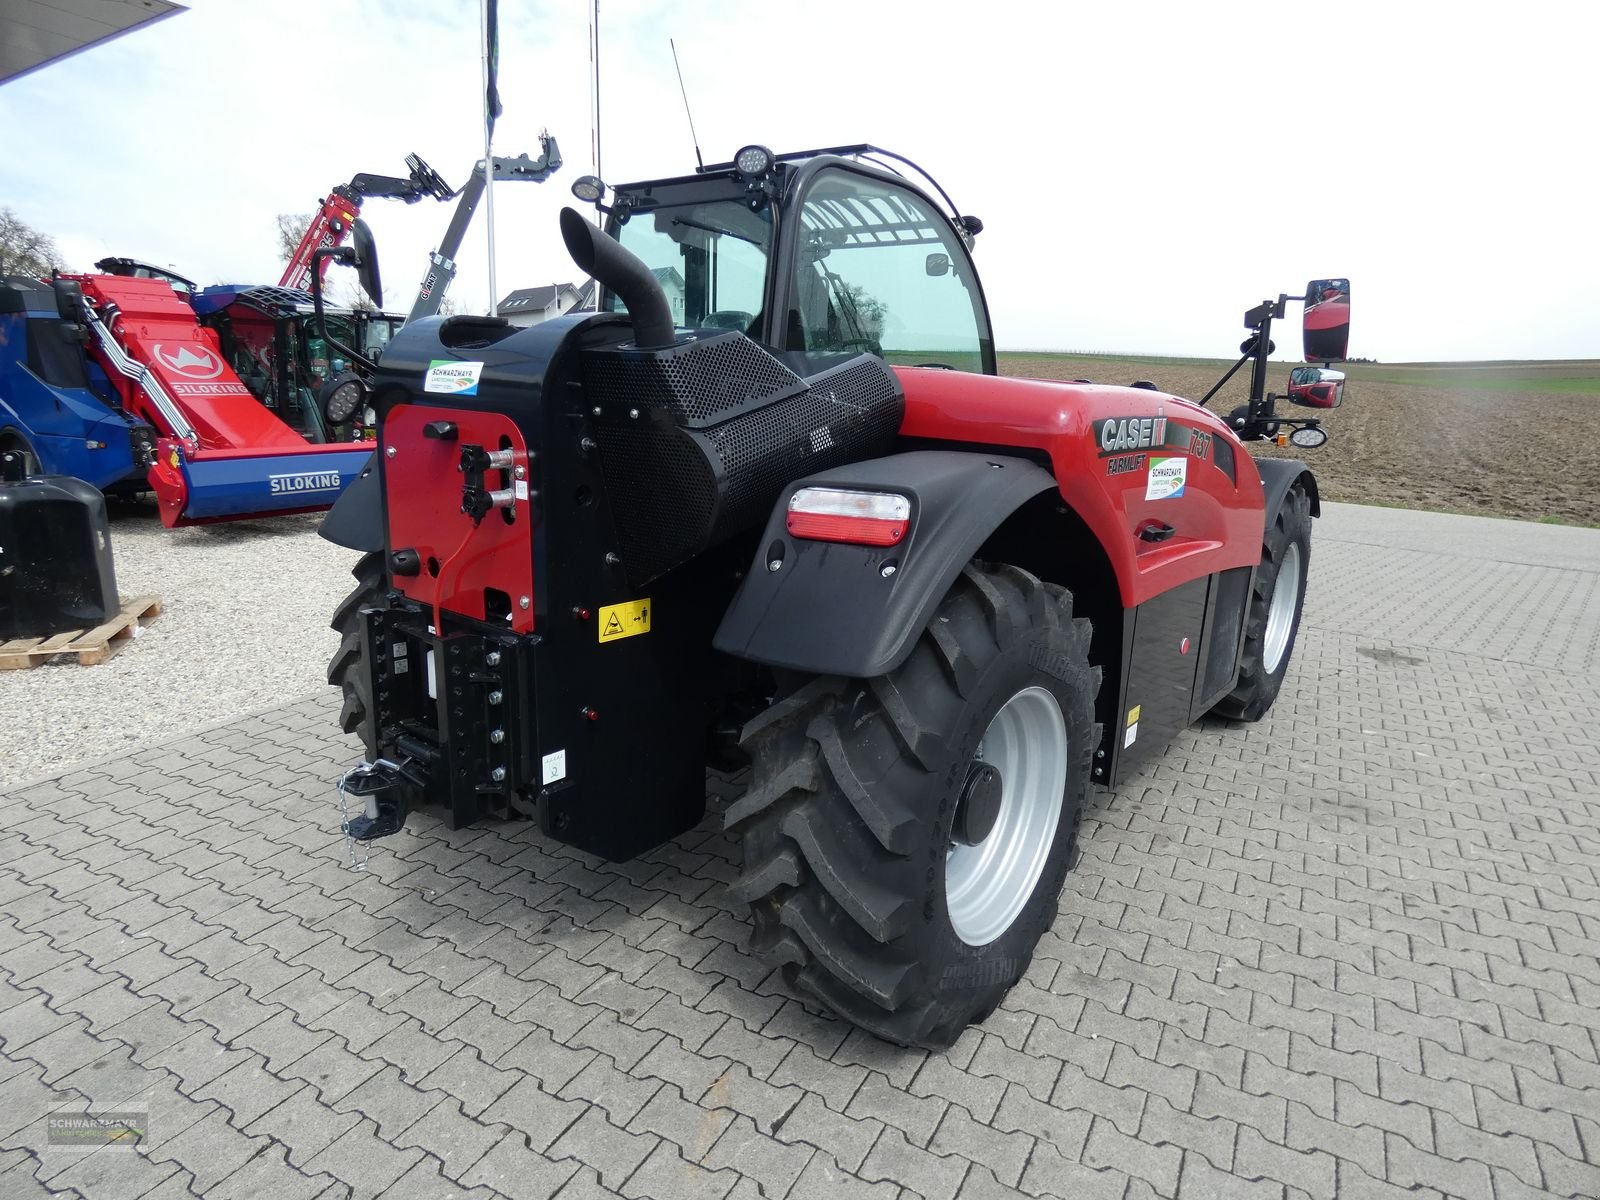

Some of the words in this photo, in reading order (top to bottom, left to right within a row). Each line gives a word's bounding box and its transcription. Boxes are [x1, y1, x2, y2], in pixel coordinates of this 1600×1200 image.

[431, 369, 473, 377] SCHWARZMAYR
[173, 384, 250, 394] SILOKING
[1102, 418, 1152, 451] CASE
[1189, 427, 1213, 461] 737
[1107, 454, 1147, 476] FARMLIFT
[1152, 468, 1182, 477] SCHWARZMAYR
[270, 474, 341, 492] SILOKING
